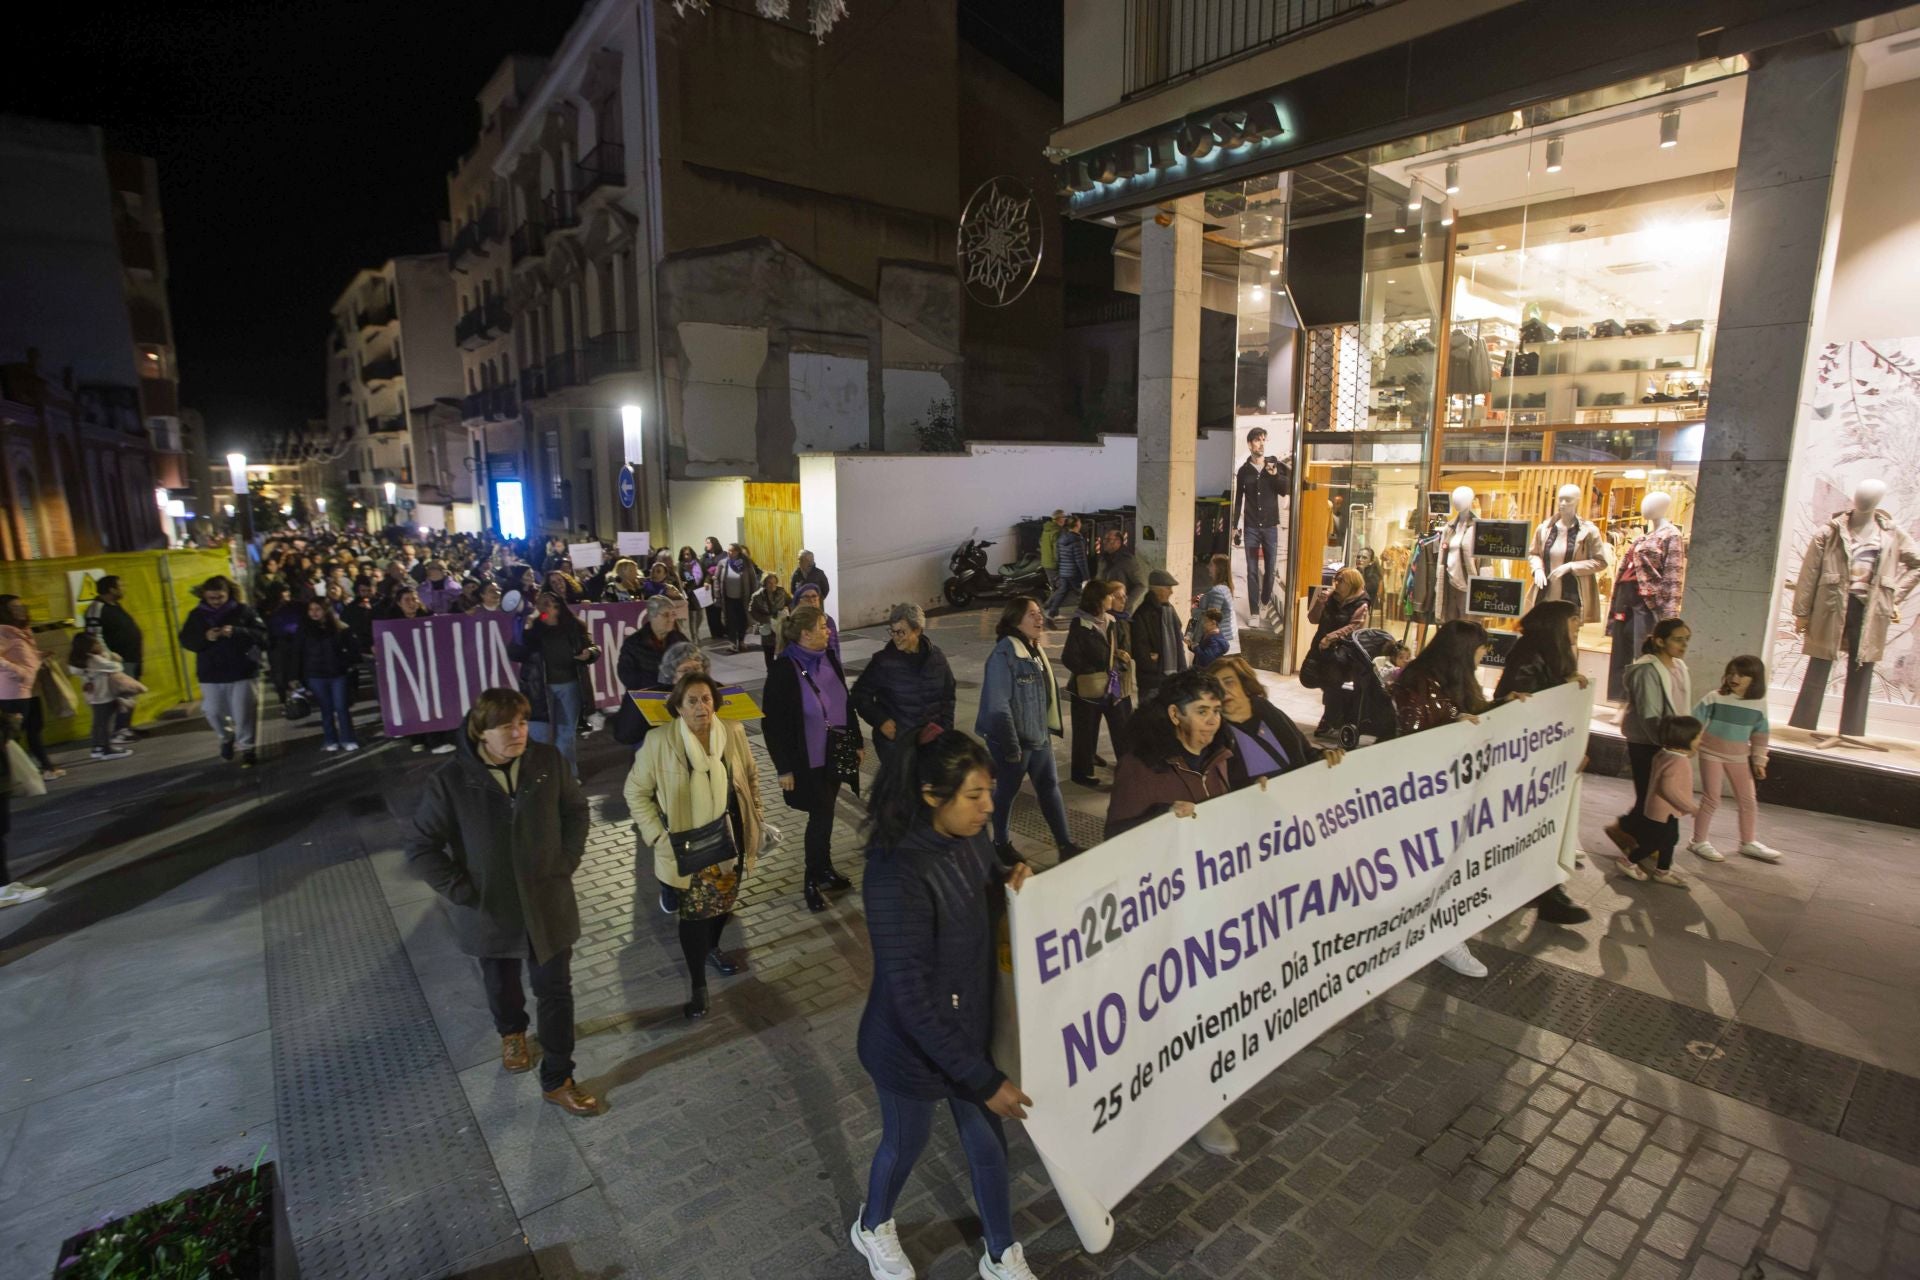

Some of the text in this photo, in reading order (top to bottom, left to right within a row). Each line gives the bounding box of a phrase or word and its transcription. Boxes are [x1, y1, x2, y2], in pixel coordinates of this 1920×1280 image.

[1483, 600, 1518, 615] Friday
[1488, 543, 1523, 557] Friday
[1195, 841, 1253, 891] han
[1258, 814, 1318, 863] sido
[1315, 770, 1449, 839] asesinadas
[1060, 991, 1128, 1088] NO
[1138, 847, 1398, 1022] CONSINTAMOS
[1399, 826, 1445, 878] NI
[1501, 760, 1568, 823] MÁS!!!
[1091, 1083, 1123, 1134] 25
[1129, 1059, 1154, 1102] de
[1158, 981, 1278, 1074] noviembre.
[1280, 951, 1310, 989] Día
[1311, 886, 1437, 967] Internacional
[1466, 858, 1481, 881] la
[1484, 817, 1556, 872] Eliminación
[1209, 886, 1493, 1084] de la Violencia contra las Mujeres.
